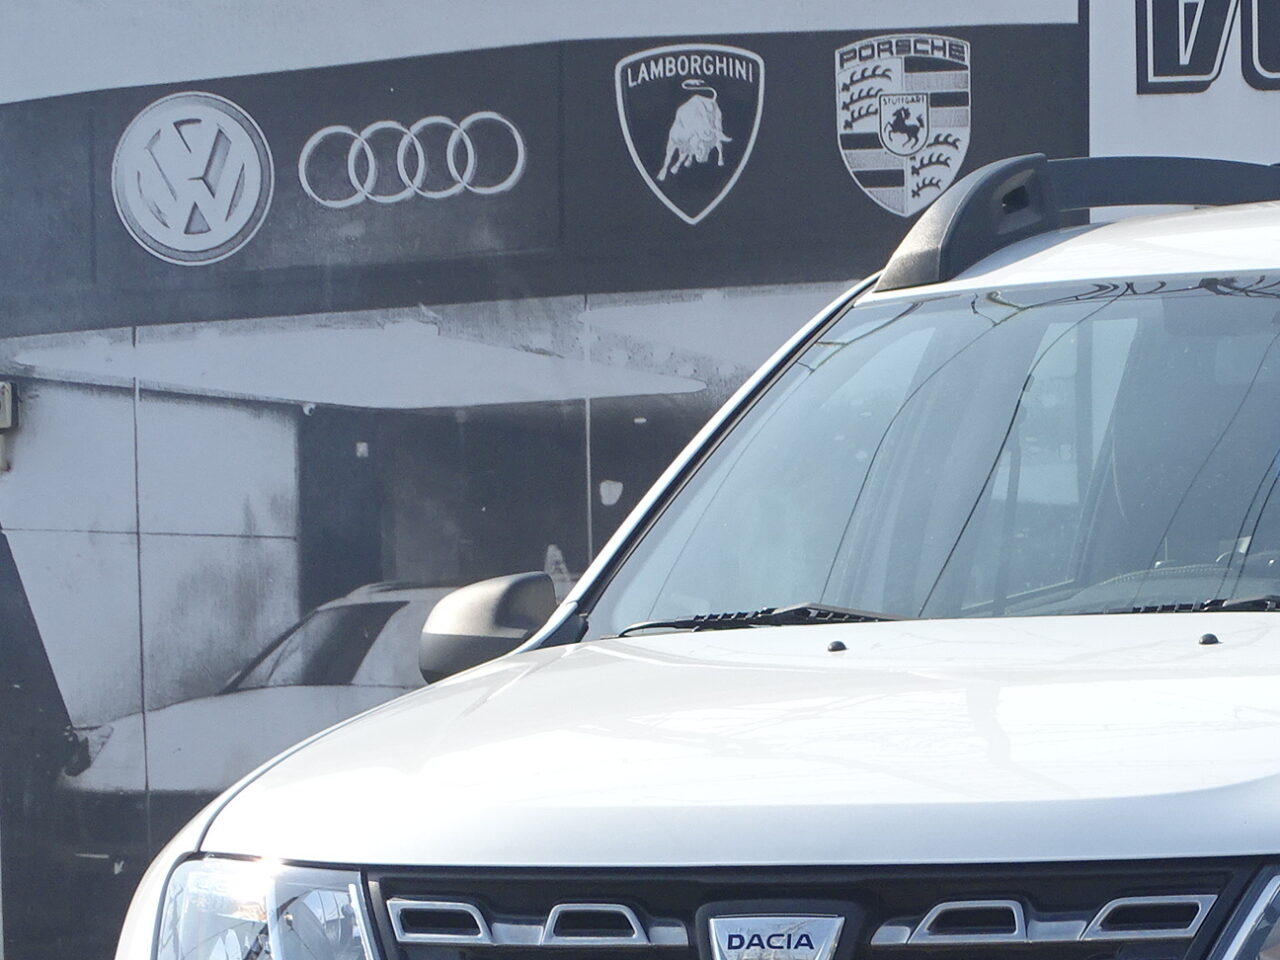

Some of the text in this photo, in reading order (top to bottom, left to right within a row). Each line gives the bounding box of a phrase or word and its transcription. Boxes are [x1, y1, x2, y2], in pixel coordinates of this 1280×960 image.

[838, 38, 967, 69] PORSCHE
[627, 54, 753, 87] LAMBORGHINI
[727, 933, 815, 950] DACIA
